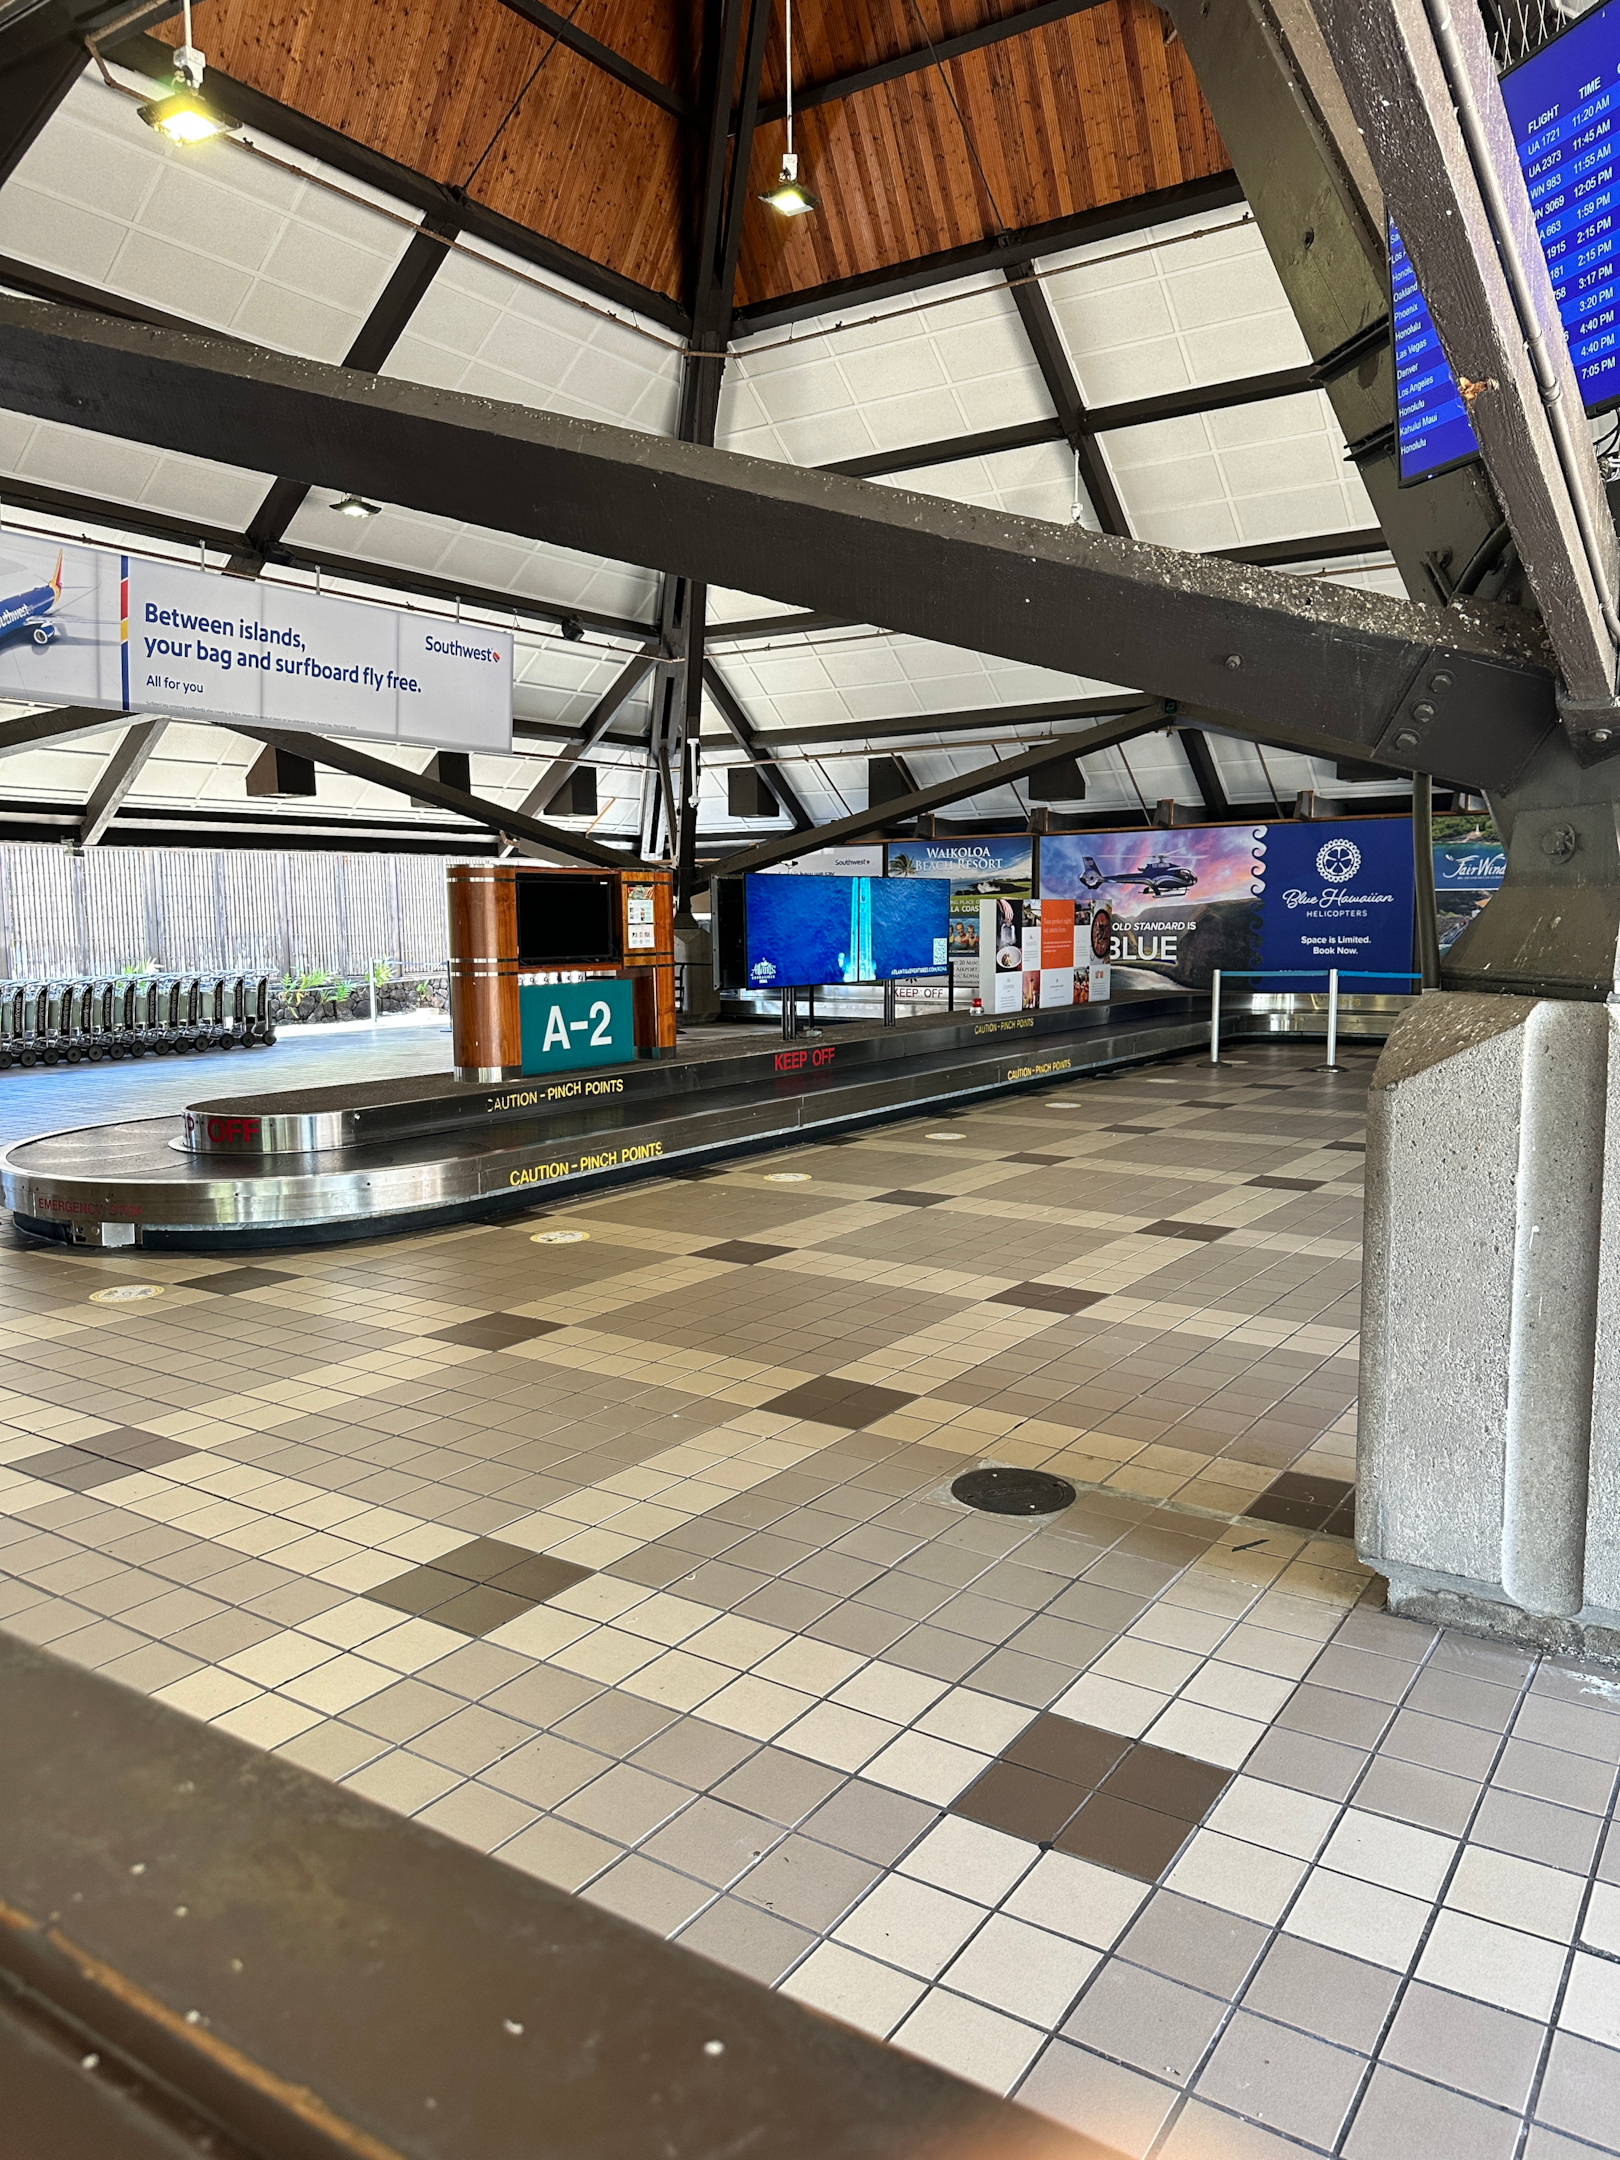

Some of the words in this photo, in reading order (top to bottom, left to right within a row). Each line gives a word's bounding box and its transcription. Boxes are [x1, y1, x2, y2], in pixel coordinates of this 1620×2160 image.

[1528, 104, 1559, 134] FLIGHT
[1579, 76, 1601, 99] TIME
[1528, 140, 1540, 155] UA
[1542, 127, 1560, 146] 1721
[1572, 105, 1594, 127] 11:20
[1595, 94, 1610, 114] AM
[1528, 163, 1541, 178] UA
[1542, 150, 1561, 171] 2373
[1573, 128, 1595, 151] 11:45
[1596, 119, 1611, 138] AM
[1530, 183, 1545, 200] WN
[1546, 173, 1561, 191] 983
[1573, 153, 1596, 174] 11:55
[1597, 143, 1611, 161] AM
[1545, 195, 1565, 215] 3069
[1574, 176, 1596, 198] 12:05
[1598, 166, 1612, 185] PM
[1546, 220, 1561, 237] 663
[1577, 201, 1594, 220] 1:59
[1596, 192, 1611, 210] PM
[1547, 240, 1566, 259] 1915
[1577, 224, 1595, 244] 2:15
[1597, 216, 1611, 233] PM
[1578, 248, 1596, 266] 2:15
[1598, 239, 1612, 256] PM
[1579, 271, 1596, 289] 3:17
[1599, 263, 1613, 280] PM
[1393, 281, 1418, 303] Oakland
[1579, 294, 1597, 312] 3:20
[1599, 286, 1613, 303] PM
[1394, 303, 1418, 322] Phoenix
[1580, 317, 1598, 334] 4:40
[1600, 310, 1614, 326] PM
[1395, 321, 1421, 341] Honolulu
[1396, 348, 1407, 361] Las
[1408, 339, 1427, 354] Vegas
[1581, 340, 1599, 357] 4:40
[1601, 333, 1615, 349] PM
[1397, 363, 1418, 380] Denver
[1582, 363, 1600, 380] 7:05
[1601, 356, 1615, 372] PM
[1398, 388, 1409, 399] Los
[1409, 376, 1434, 392] Angeles
[1399, 400, 1425, 418] Honolulu
[1400, 419, 1421, 436] Kahului
[1422, 412, 1438, 427] Maui
[1401, 438, 1426, 455] Honolulu
[145, 602, 234, 637] Between
[239, 618, 306, 653] islands,
[425, 636, 492, 662] Southwest
[144, 636, 192, 658] your
[197, 640, 232, 670] bag
[237, 651, 271, 671] and
[275, 657, 359, 683] surfboard
[363, 667, 384, 691] fly
[387, 671, 422, 693] free.
[146, 675, 161, 687] All
[164, 677, 181, 690] for
[183, 682, 203, 694] you
[915, 860, 953, 871] BEACH
[958, 858, 1003, 870] RESORT
[926, 847, 991, 859] WAIKOLOA
[1282, 889, 1318, 909] Blue
[1319, 888, 1394, 908] Hawaiian
[1134, 921, 1186, 931] STANDARD
[1187, 922, 1197, 931] IS
[1307, 910, 1368, 918] HELICOPTERS
[1301, 936, 1327, 945] Space
[1329, 936, 1336, 944] is
[1338, 936, 1371, 944] Limited.
[1337, 947, 1358, 955] Now.
[894, 988, 919, 998] KEEP
[924, 988, 943, 998] OFF
[542, 1000, 613, 1052] A-2
[974, 1022, 997, 1035] CAUTION
[1000, 1020, 1016, 1031] PINCH
[1017, 1018, 1034, 1028] POINTS
[774, 1050, 808, 1071] KEEP
[812, 1047, 835, 1066] OFF
[1007, 1066, 1032, 1080] CAUTION
[1035, 1063, 1051, 1074] PINCH
[1052, 1059, 1072, 1070] POINTS
[485, 1091, 538, 1113] CAUTION
[547, 1081, 582, 1101] PINCH
[585, 1079, 624, 1095] POINTS
[207, 1118, 260, 1143] OFF
[510, 1162, 569, 1186] CAUTION
[580, 1152, 617, 1171] PINCH
[621, 1141, 663, 1162] POINTS
[38, 1198, 103, 1215] EMERGENCY
[108, 1204, 144, 1216] STOP
